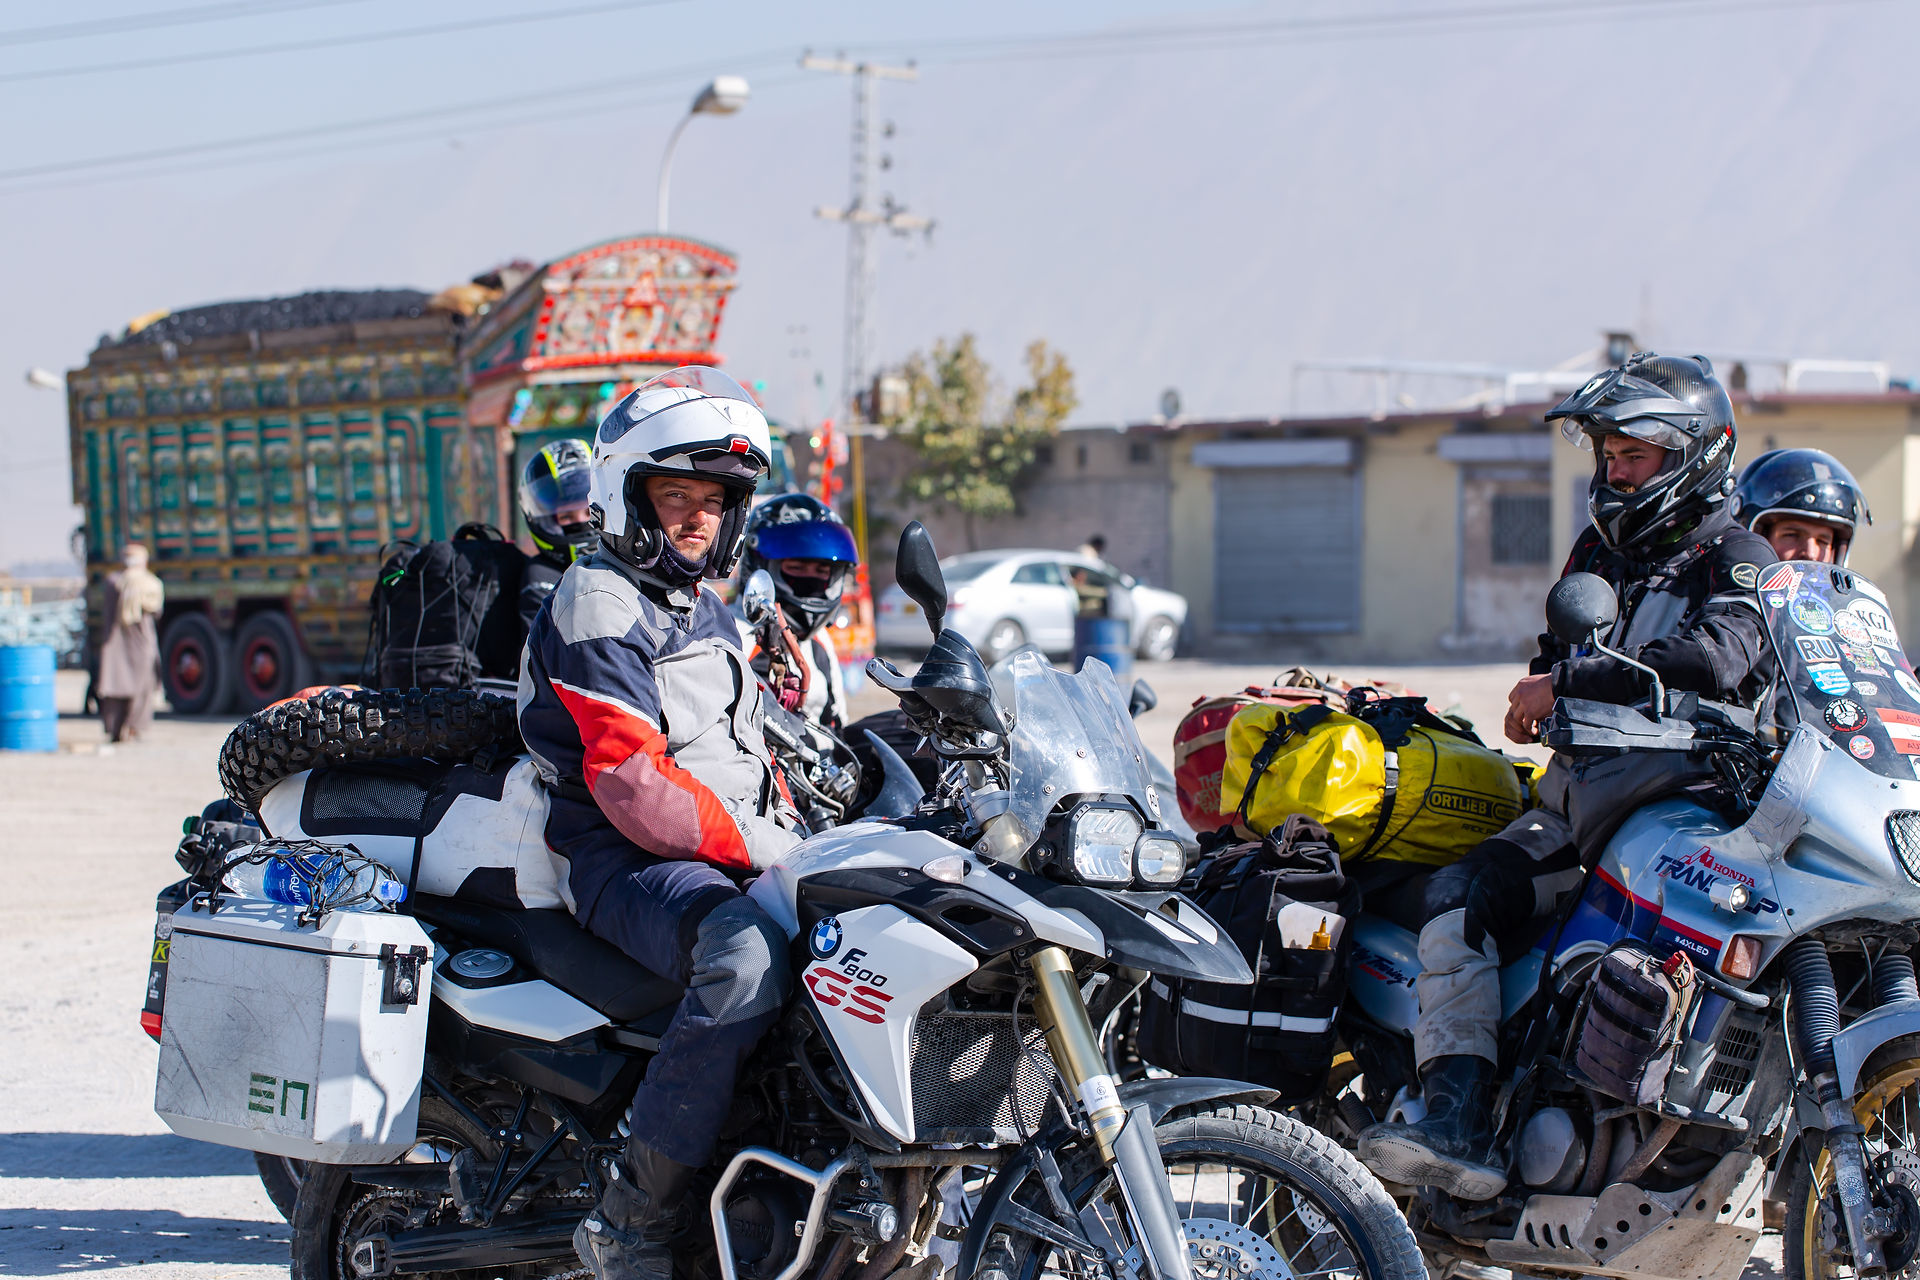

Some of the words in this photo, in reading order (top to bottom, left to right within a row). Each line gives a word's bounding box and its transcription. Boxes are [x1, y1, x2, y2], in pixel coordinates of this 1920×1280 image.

[1703, 432, 1729, 464] NISHUA
[1787, 571, 1804, 600] HONDA
[1798, 639, 1838, 661] RU
[1431, 792, 1488, 815] ORTLIEB
[734, 814, 752, 837] BMW
[1712, 862, 1756, 888] HONDA
[817, 918, 843, 936] BMW
[838, 948, 868, 966] F
[843, 963, 888, 987] 800
[804, 966, 895, 1025] GS
